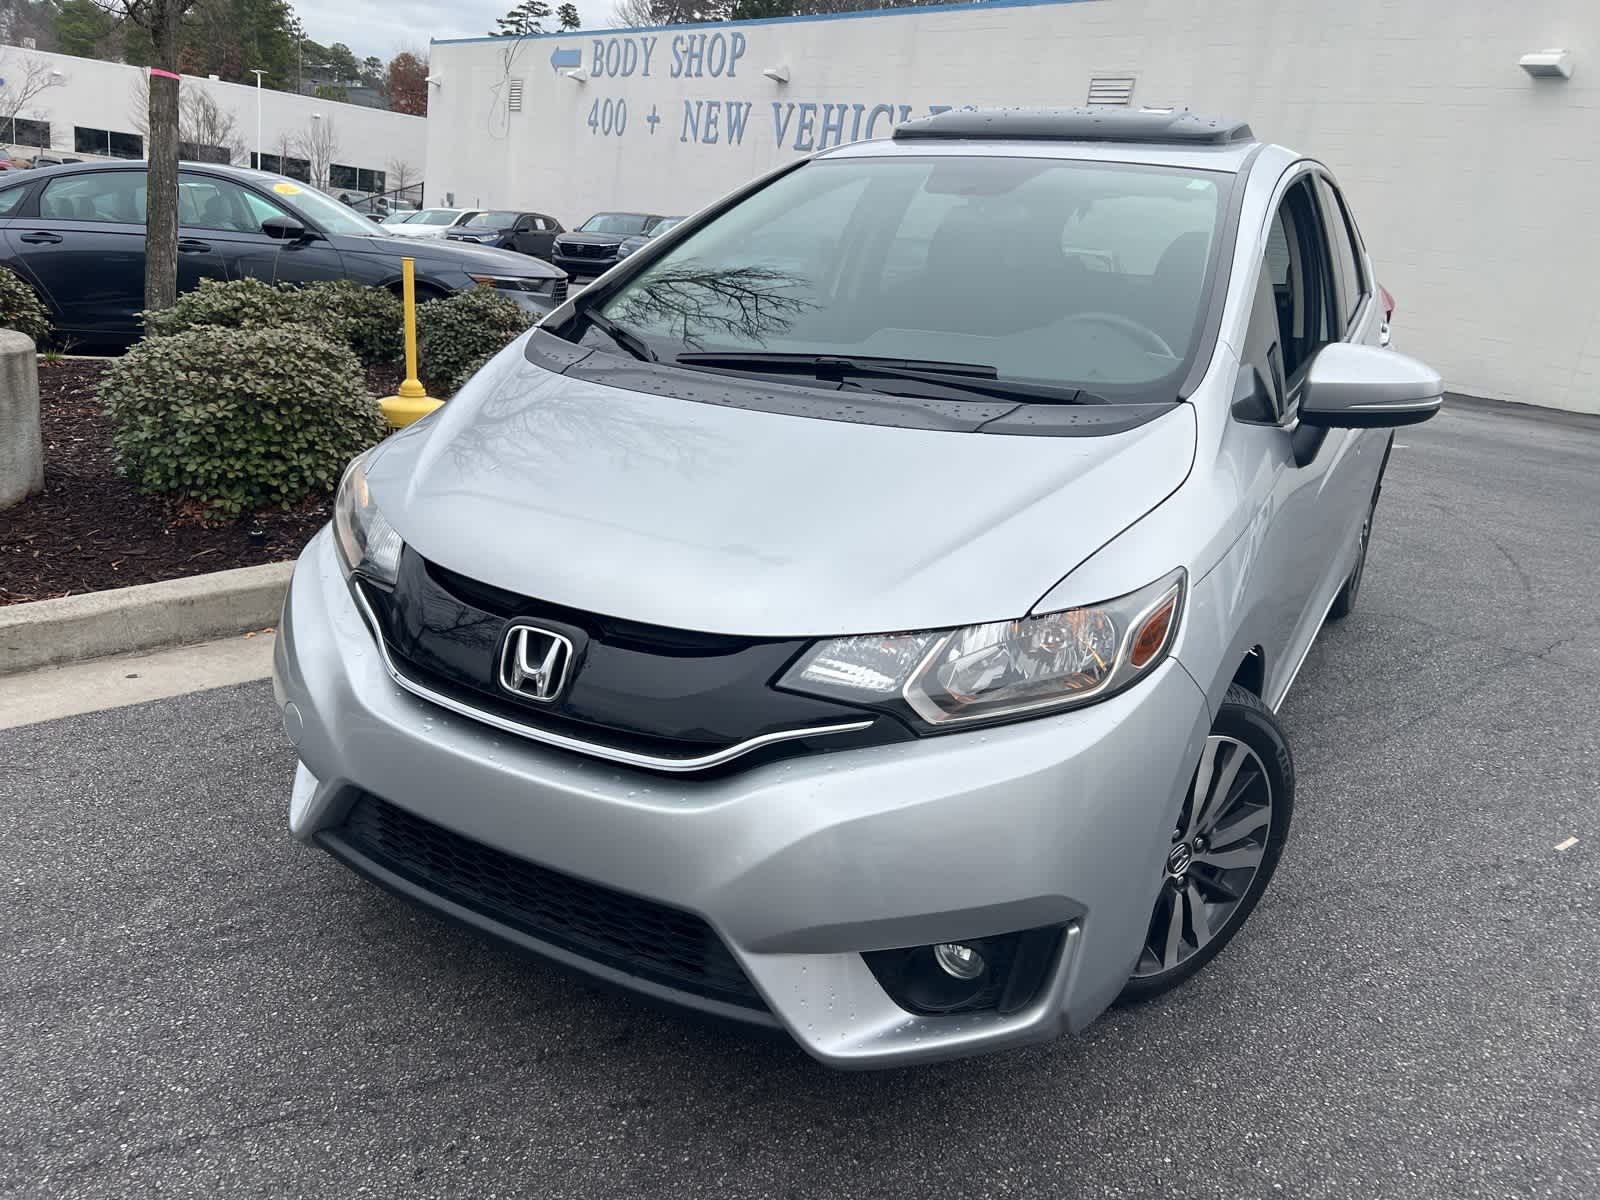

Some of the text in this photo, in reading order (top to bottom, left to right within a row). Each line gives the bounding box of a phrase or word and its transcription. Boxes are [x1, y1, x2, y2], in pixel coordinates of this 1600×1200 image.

[590, 32, 746, 78] BODY SHOP
[587, 97, 978, 152] 400 + NEW VEHIC
